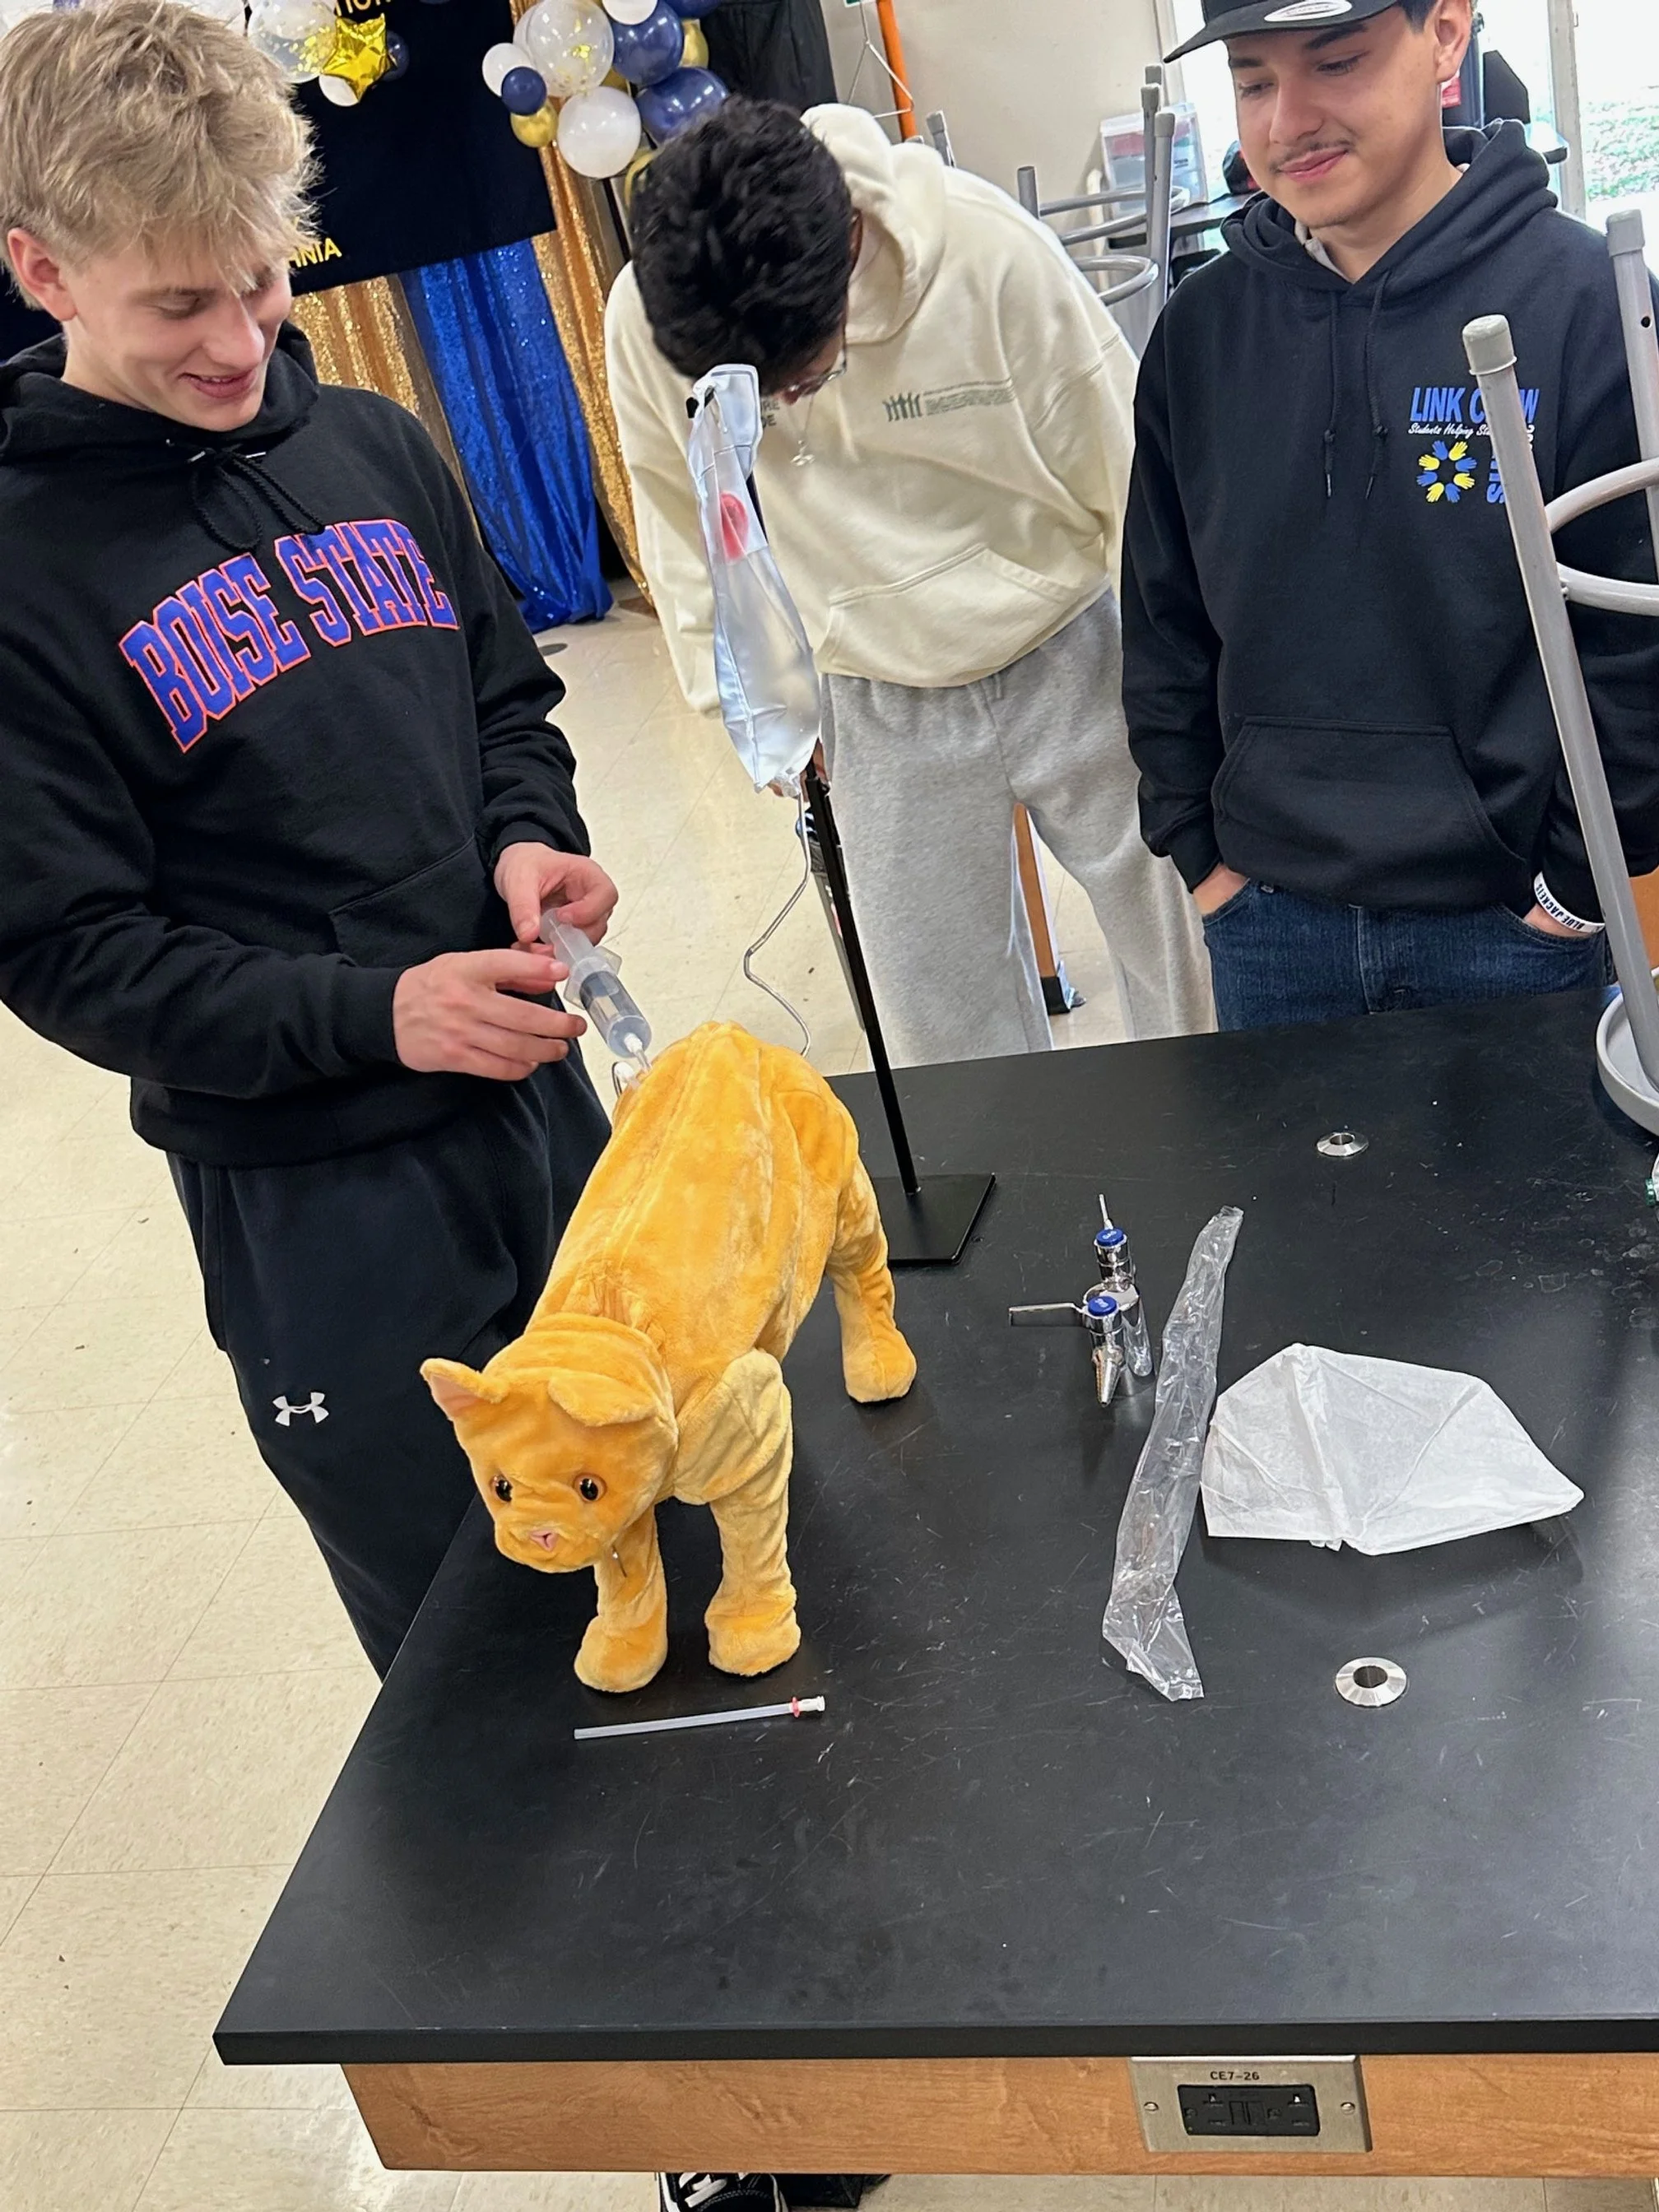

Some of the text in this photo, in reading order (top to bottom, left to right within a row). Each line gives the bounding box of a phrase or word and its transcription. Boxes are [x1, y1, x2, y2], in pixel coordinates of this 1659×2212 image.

[1410, 387, 1540, 425] LINK CW
[1408, 423, 1442, 434] Students
[1443, 422, 1474, 439] Helping
[118, 518, 460, 754] BOISE STATE
[1535, 883, 1586, 931] BLUE JACKETS
[1210, 2070, 1260, 2081] CE7-26
